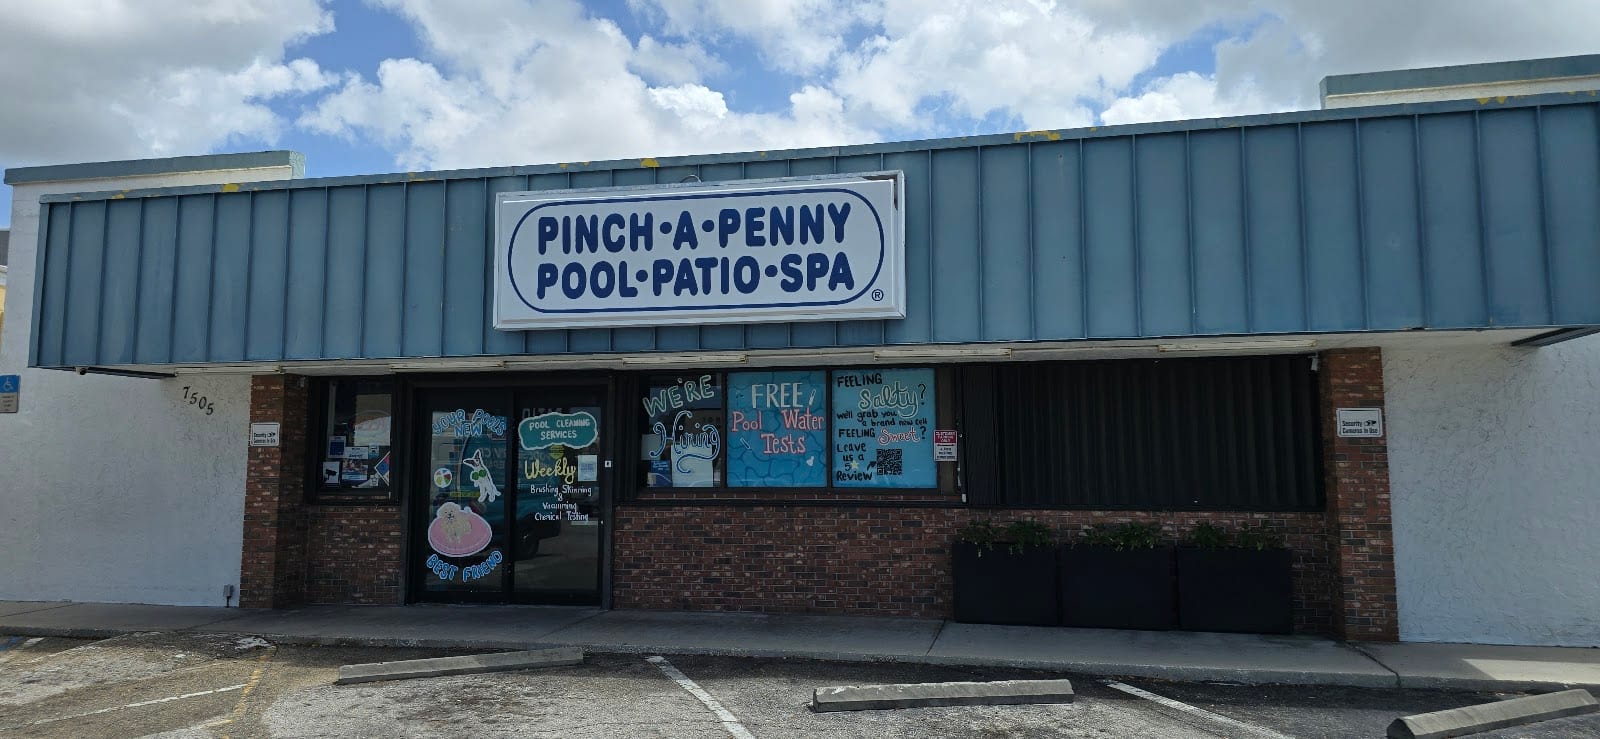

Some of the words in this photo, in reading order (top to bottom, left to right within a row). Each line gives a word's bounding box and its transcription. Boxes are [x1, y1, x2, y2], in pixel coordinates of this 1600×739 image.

[537, 211, 654, 256] PINCH
[718, 201, 851, 248] PENNY
[537, 260, 639, 300] POOL
[652, 255, 761, 297] PATIO
[780, 251, 855, 293] SPA
[837, 373, 882, 388] FEELING
[183, 386, 215, 416] 7505
[642, 374, 715, 418] WE'RE
[432, 408, 466, 435] YOUR
[731, 410, 762, 432] Pool
[781, 407, 825, 431] Water
[857, 410, 878, 422] grab
[881, 411, 898, 419] you
[871, 418, 896, 427] brand
[915, 418, 928, 426] cell
[453, 423, 483, 438] NEW
[529, 420, 550, 432] POOL
[556, 418, 591, 428] CLEANING
[838, 427, 876, 438] FEELING
[540, 430, 578, 441] SERVICES
[649, 410, 721, 474] Hiring
[760, 432, 807, 455] Tests
[837, 443, 867, 453] Leave
[842, 454, 854, 462] us
[524, 456, 577, 485] Weekly
[844, 463, 851, 471] 5
[836, 470, 873, 481] Review
[530, 483, 559, 497] Brushing
[566, 511, 589, 522] Testing
[426, 553, 459, 580] BEST
[462, 550, 503, 583] FRIEND
